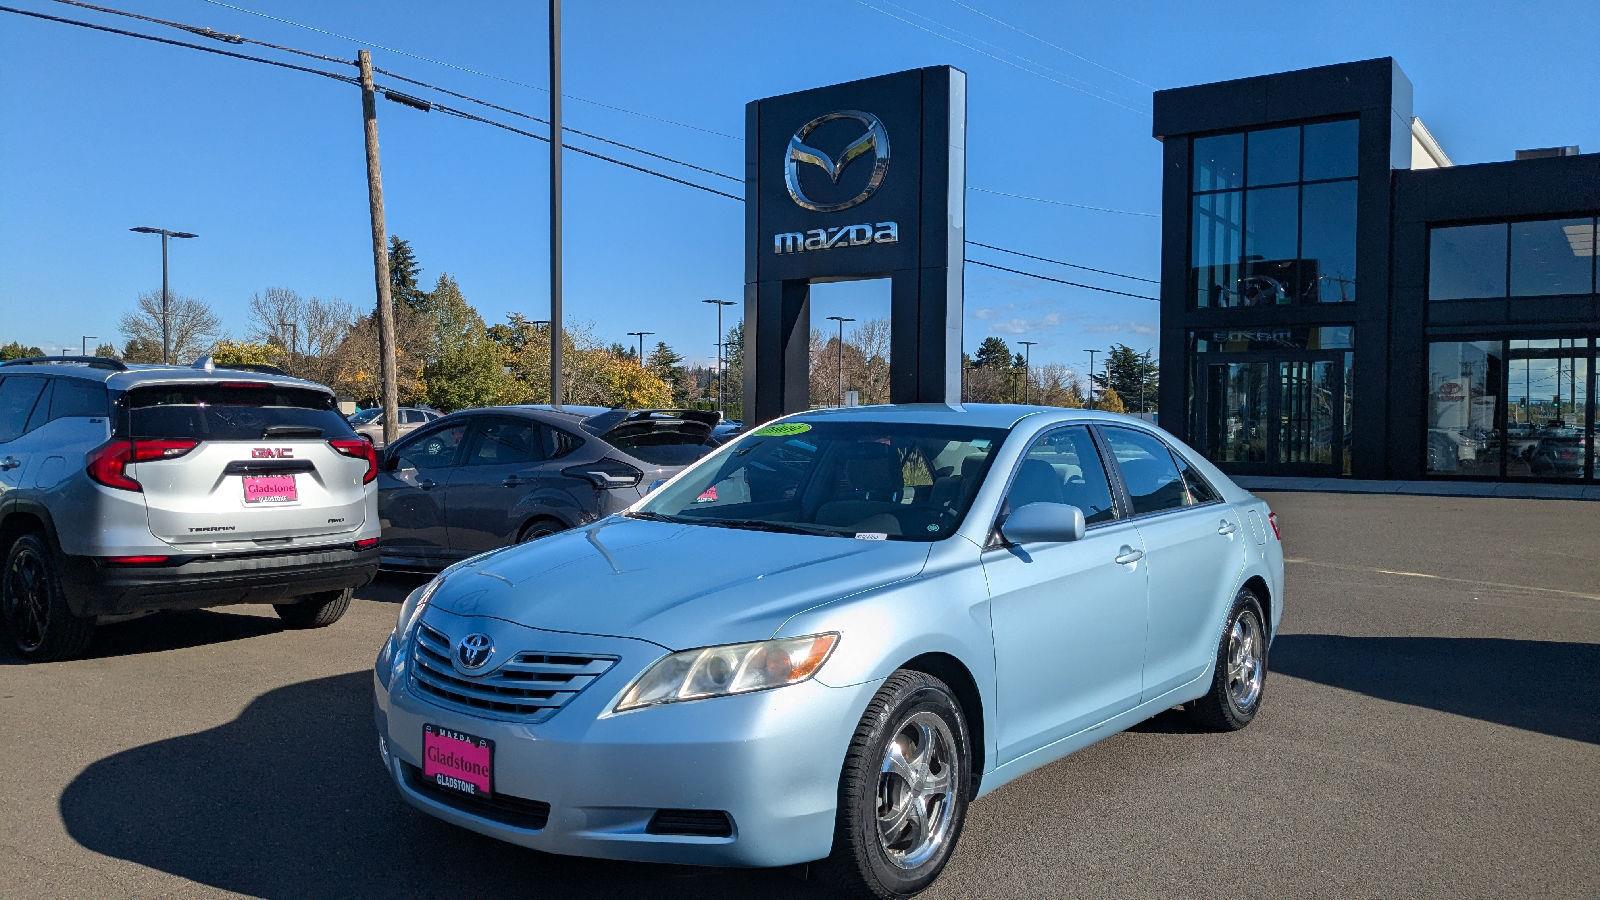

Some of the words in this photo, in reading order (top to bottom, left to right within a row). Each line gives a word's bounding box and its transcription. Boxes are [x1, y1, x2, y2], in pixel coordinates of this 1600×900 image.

[251, 447, 294, 459] GMC
[247, 484, 295, 493] Gladstone
[188, 525, 236, 533] TERRAIN
[439, 728, 471, 744] MAZDA
[427, 745, 489, 778] Gladstone
[436, 773, 475, 795] GLADSTONE
